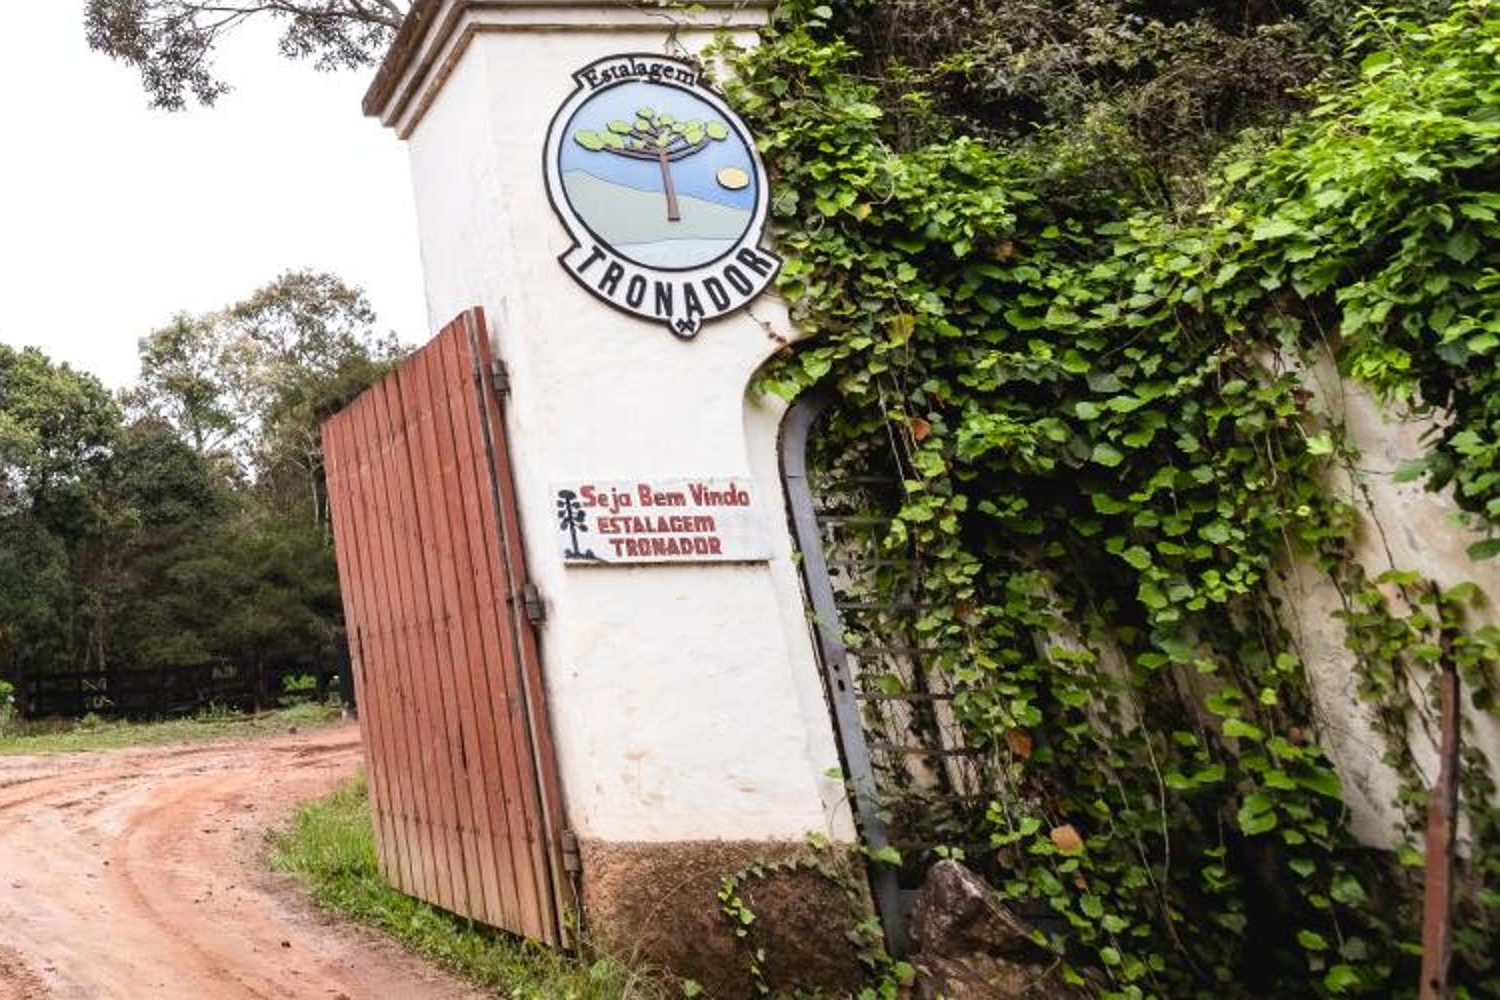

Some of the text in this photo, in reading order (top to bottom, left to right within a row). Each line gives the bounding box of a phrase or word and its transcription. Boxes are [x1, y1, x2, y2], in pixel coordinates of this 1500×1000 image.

[583, 58, 696, 89] Estalagem
[576, 246, 772, 318] TRONADOR
[580, 482, 750, 513] Seja Bem Vindo
[597, 516, 715, 534] ESTALAGEM
[609, 537, 722, 556] TRONADOR
